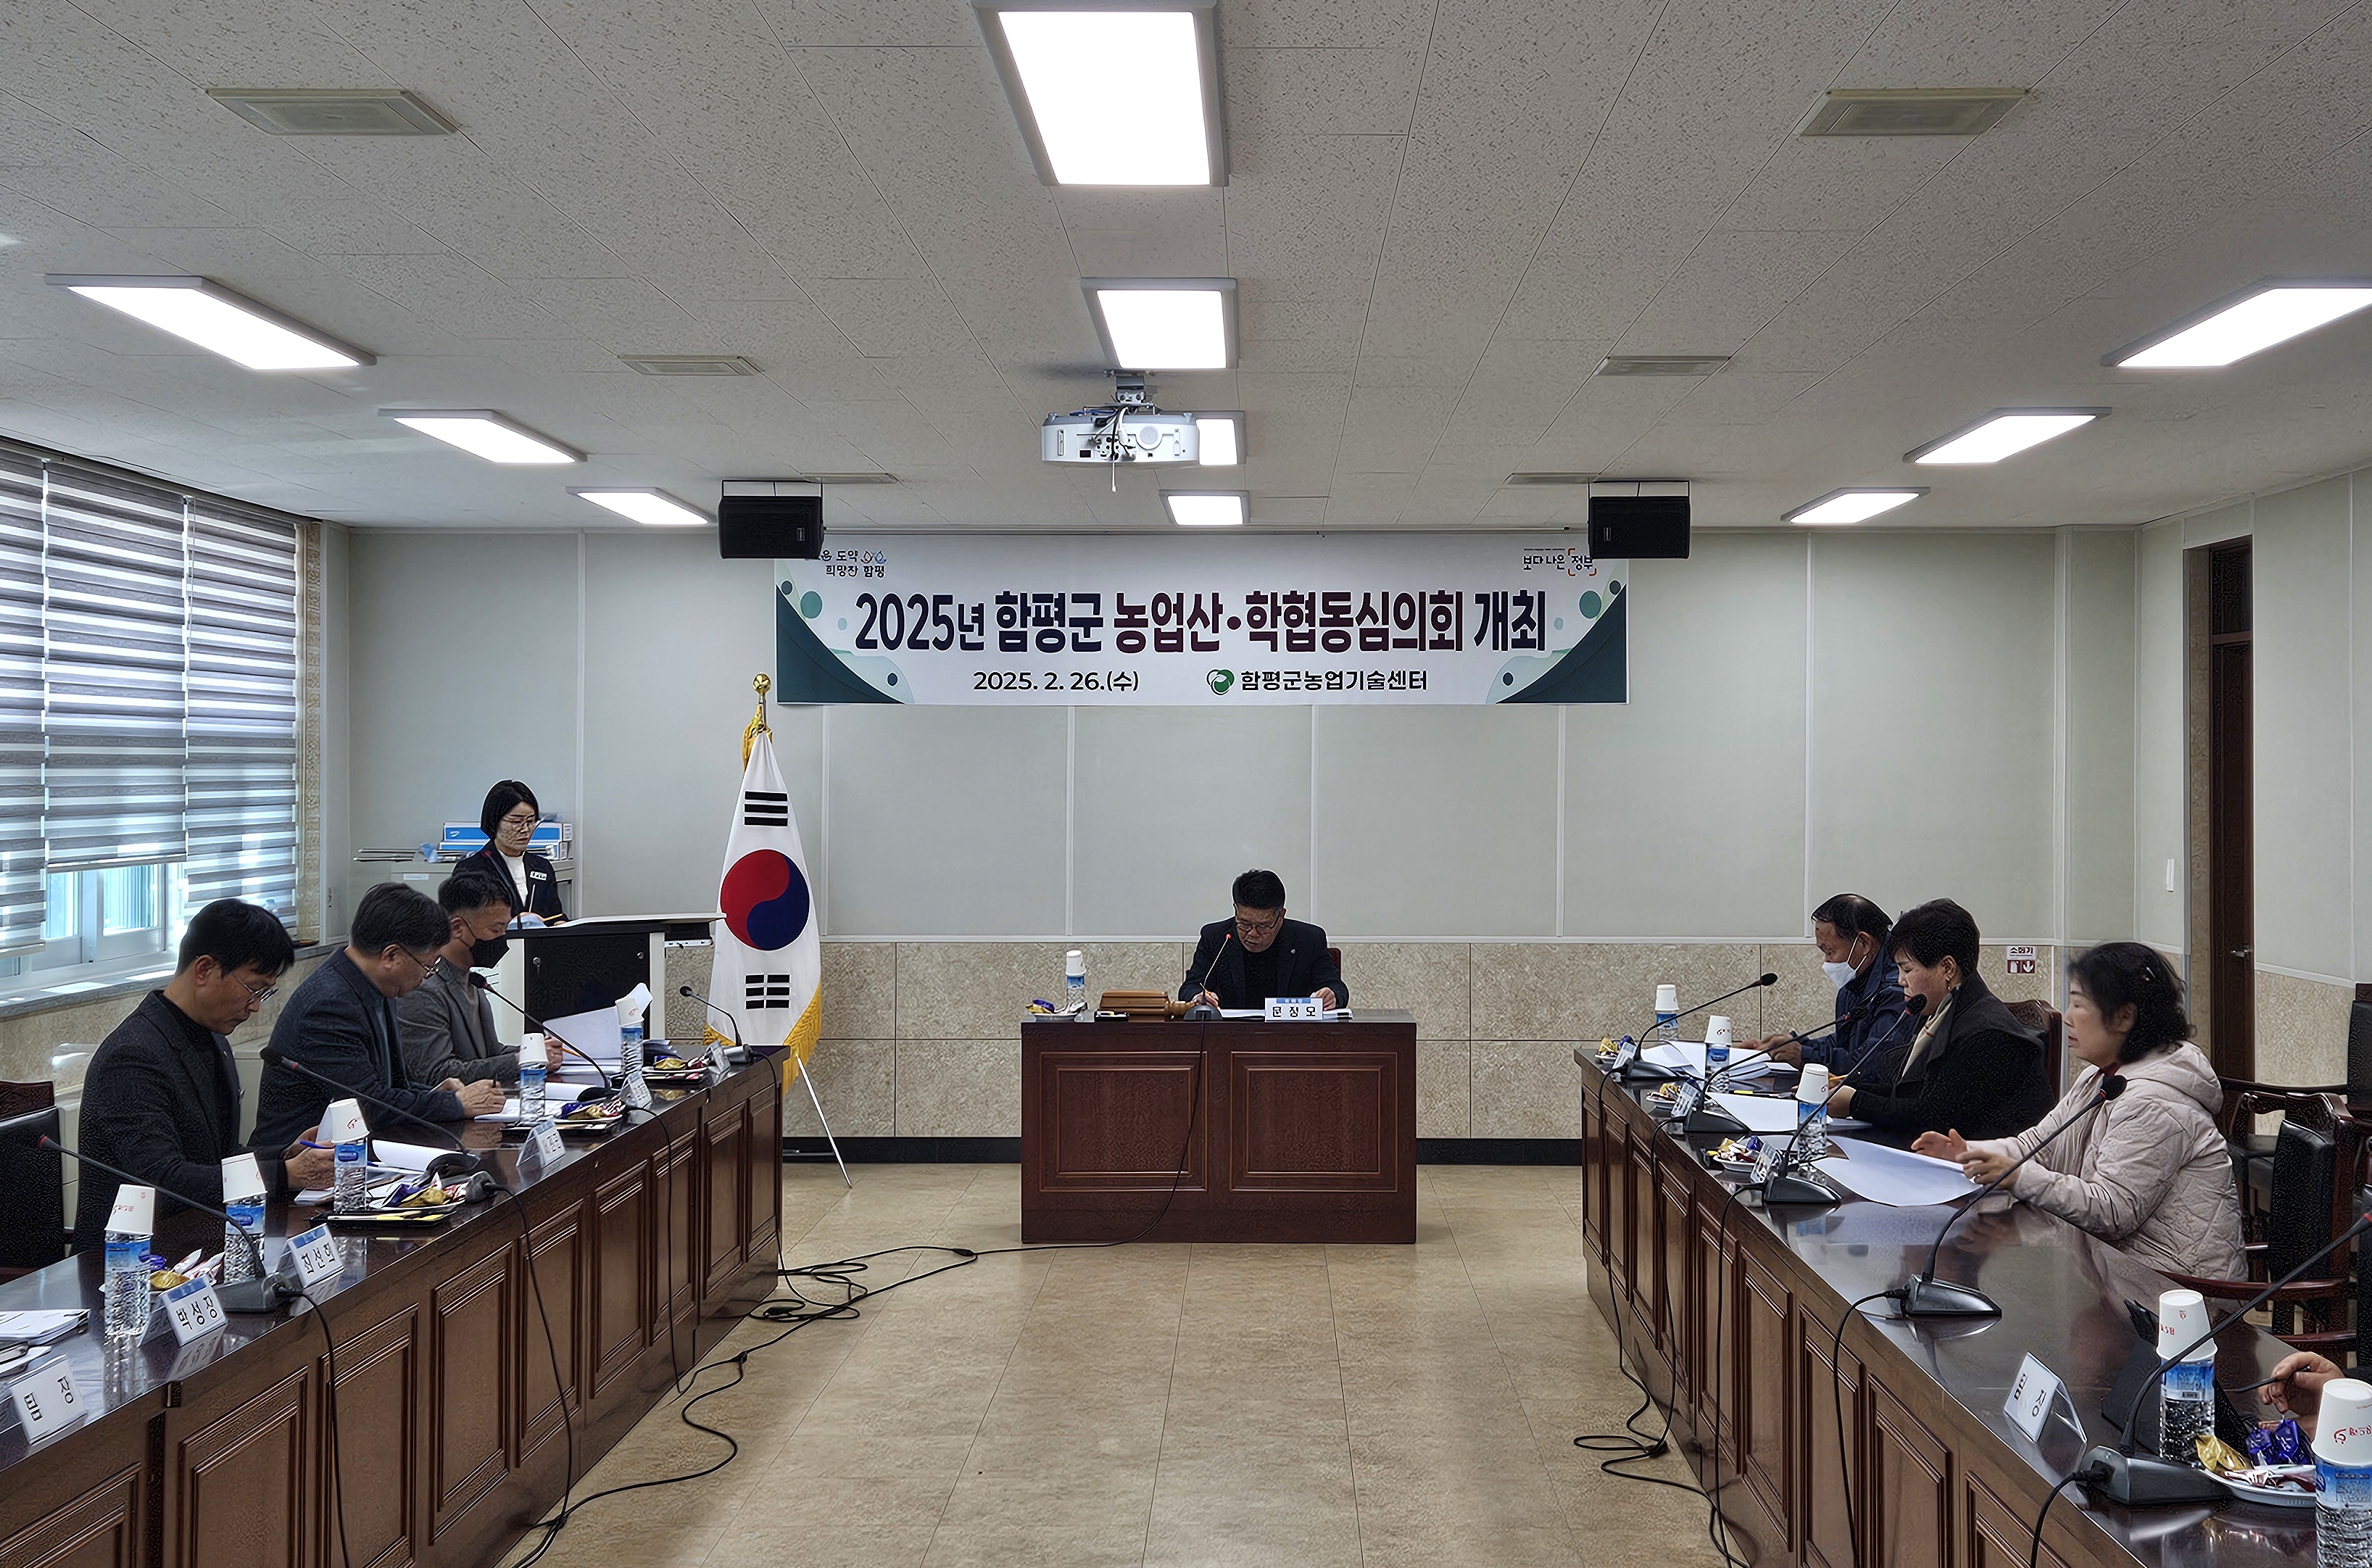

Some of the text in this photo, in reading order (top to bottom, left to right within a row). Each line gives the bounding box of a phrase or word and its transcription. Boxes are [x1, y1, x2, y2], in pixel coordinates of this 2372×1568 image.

[836, 549, 858, 563] 도약
[1523, 554, 1593, 571] 보다 나은 정부
[863, 565, 884, 578] 함평
[855, 591, 985, 652] 2025년
[995, 590, 1104, 653] 함평군
[1473, 589, 1546, 652] 개최
[973, 671, 1139, 692] 2025. 2. 26.(수)
[1240, 670, 1427, 691] 함평군농업기술센터
